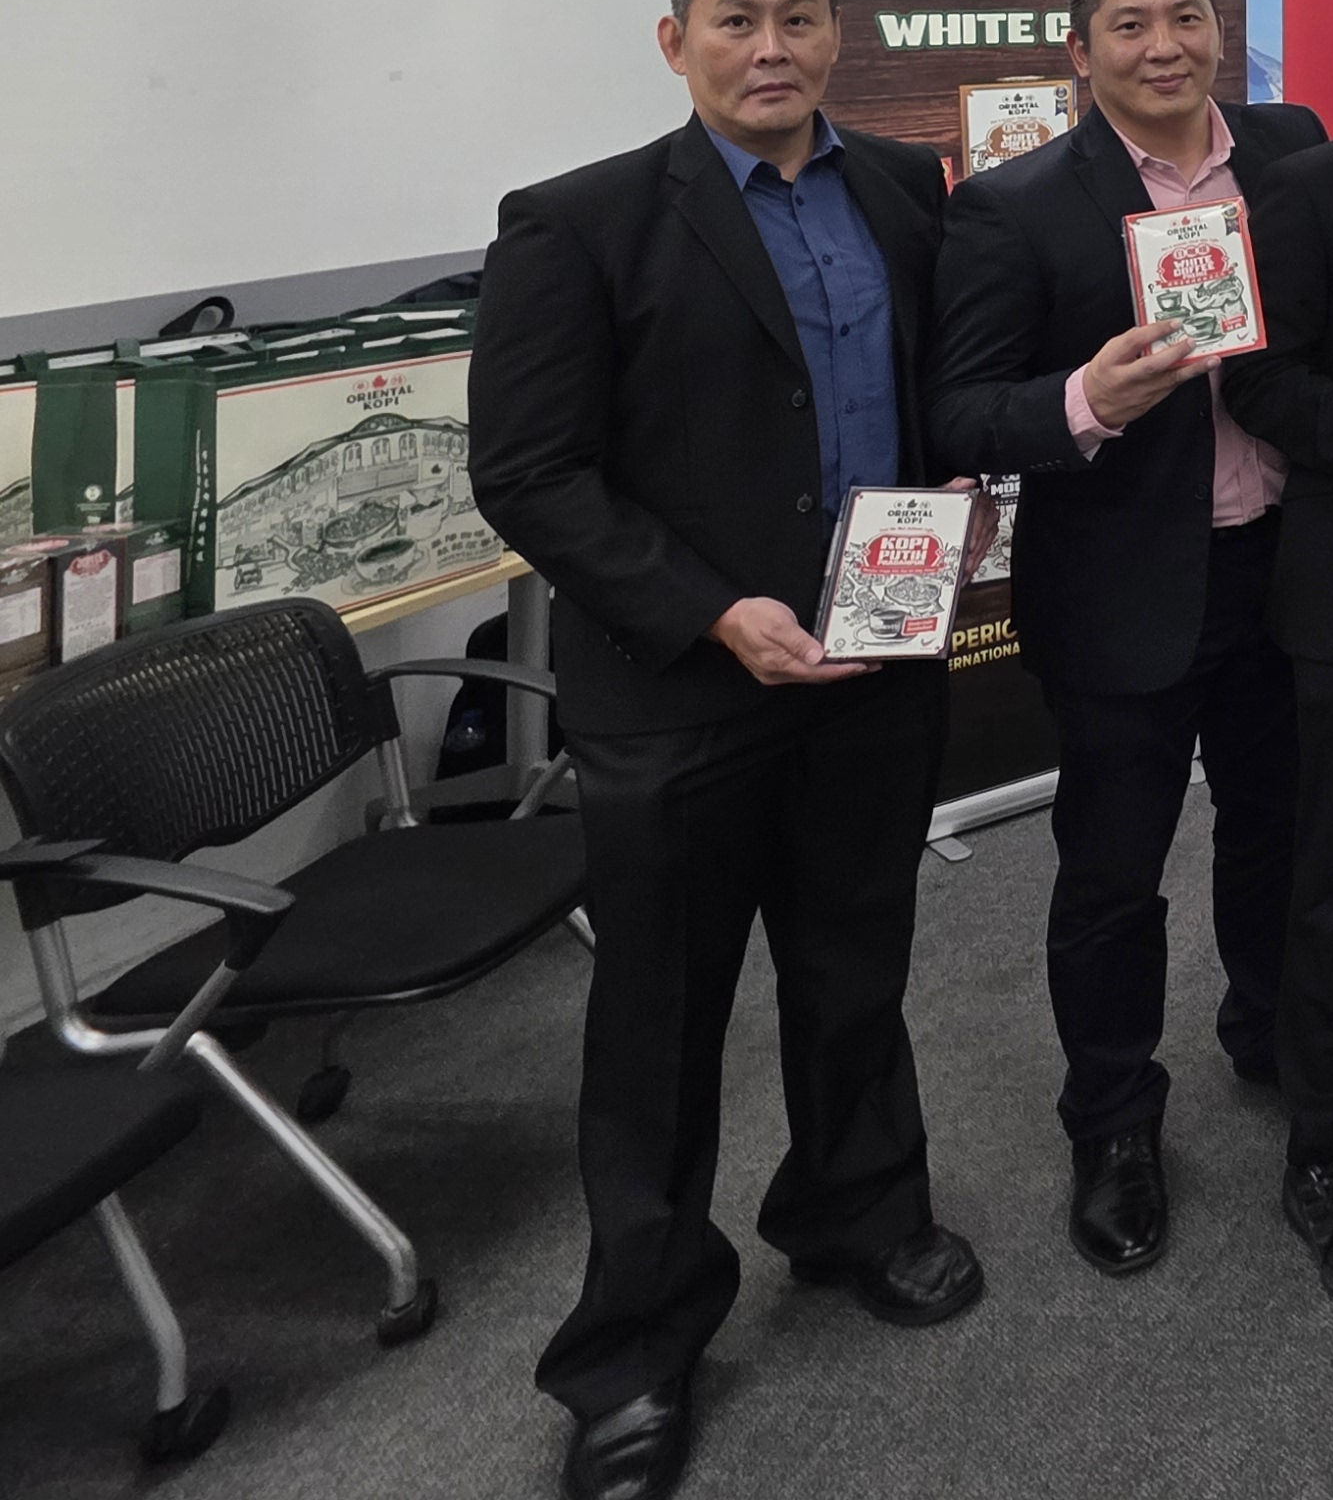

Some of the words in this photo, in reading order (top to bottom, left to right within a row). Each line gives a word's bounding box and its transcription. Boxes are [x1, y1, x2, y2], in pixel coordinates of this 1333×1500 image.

[878, 12, 1035, 47] WHITE
[1166, 223, 1209, 236] ORIENTAL
[1177, 231, 1201, 241] KOPI
[1173, 254, 1213, 271] WHITE
[346, 384, 415, 404] ORIENTAL
[363, 396, 400, 411] KOPI
[887, 509, 934, 518] ORIENTAL
[897, 516, 923, 525] KOPI
[880, 536, 930, 550] KOPI
[879, 549, 928, 562] PUTIH
